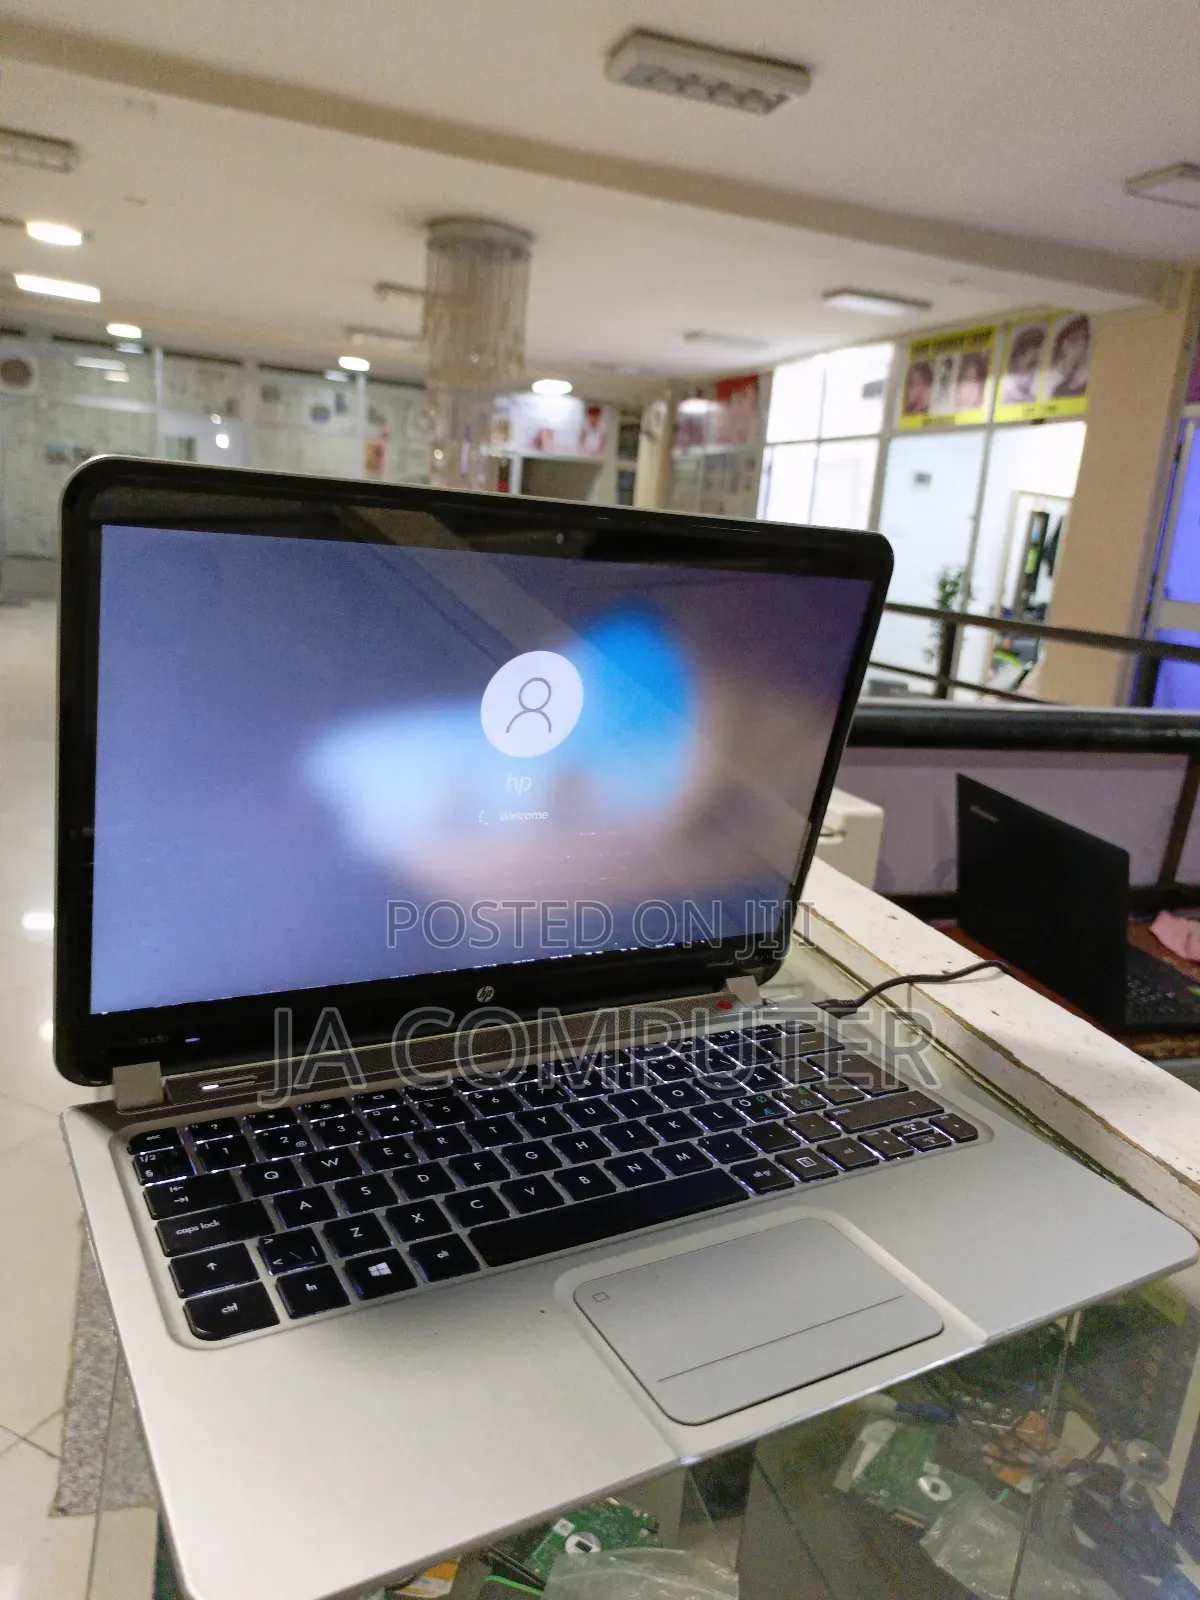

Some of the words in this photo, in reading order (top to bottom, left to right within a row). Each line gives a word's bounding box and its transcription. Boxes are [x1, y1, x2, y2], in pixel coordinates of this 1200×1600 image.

[507, 773, 532, 796] hp
[500, 811, 549, 822] Welcome
[671, 1089, 685, 1098] O
[584, 1107, 596, 1115] U
[712, 1111, 724, 1120] L
[536, 1116, 547, 1125] Y
[667, 1120, 681, 1129] K
[488, 1126, 498, 1134] T
[626, 1130, 635, 1139] J
[279, 1136, 290, 1144] 2
[436, 1136, 449, 1146] R
[575, 1140, 589, 1150] H
[382, 1147, 394, 1156] E
[525, 1151, 539, 1160] G
[675, 1152, 691, 1161] M
[321, 1157, 340, 1168] W
[473, 1161, 483, 1171] F
[626, 1163, 643, 1173] N
[263, 1170, 280, 1180] Q
[417, 1174, 430, 1183] D
[578, 1175, 591, 1185] B
[360, 1186, 372, 1196] S
[524, 1186, 535, 1196] V
[300, 1200, 313, 1210] A
[470, 1200, 484, 1209] C
[411, 1212, 425, 1223] X
[175, 1225, 200, 1235] caps
[200, 1219, 221, 1230] lock
[350, 1227, 363, 1238] Z
[305, 1283, 318, 1292] fn
[221, 1303, 239, 1314] ctrl
